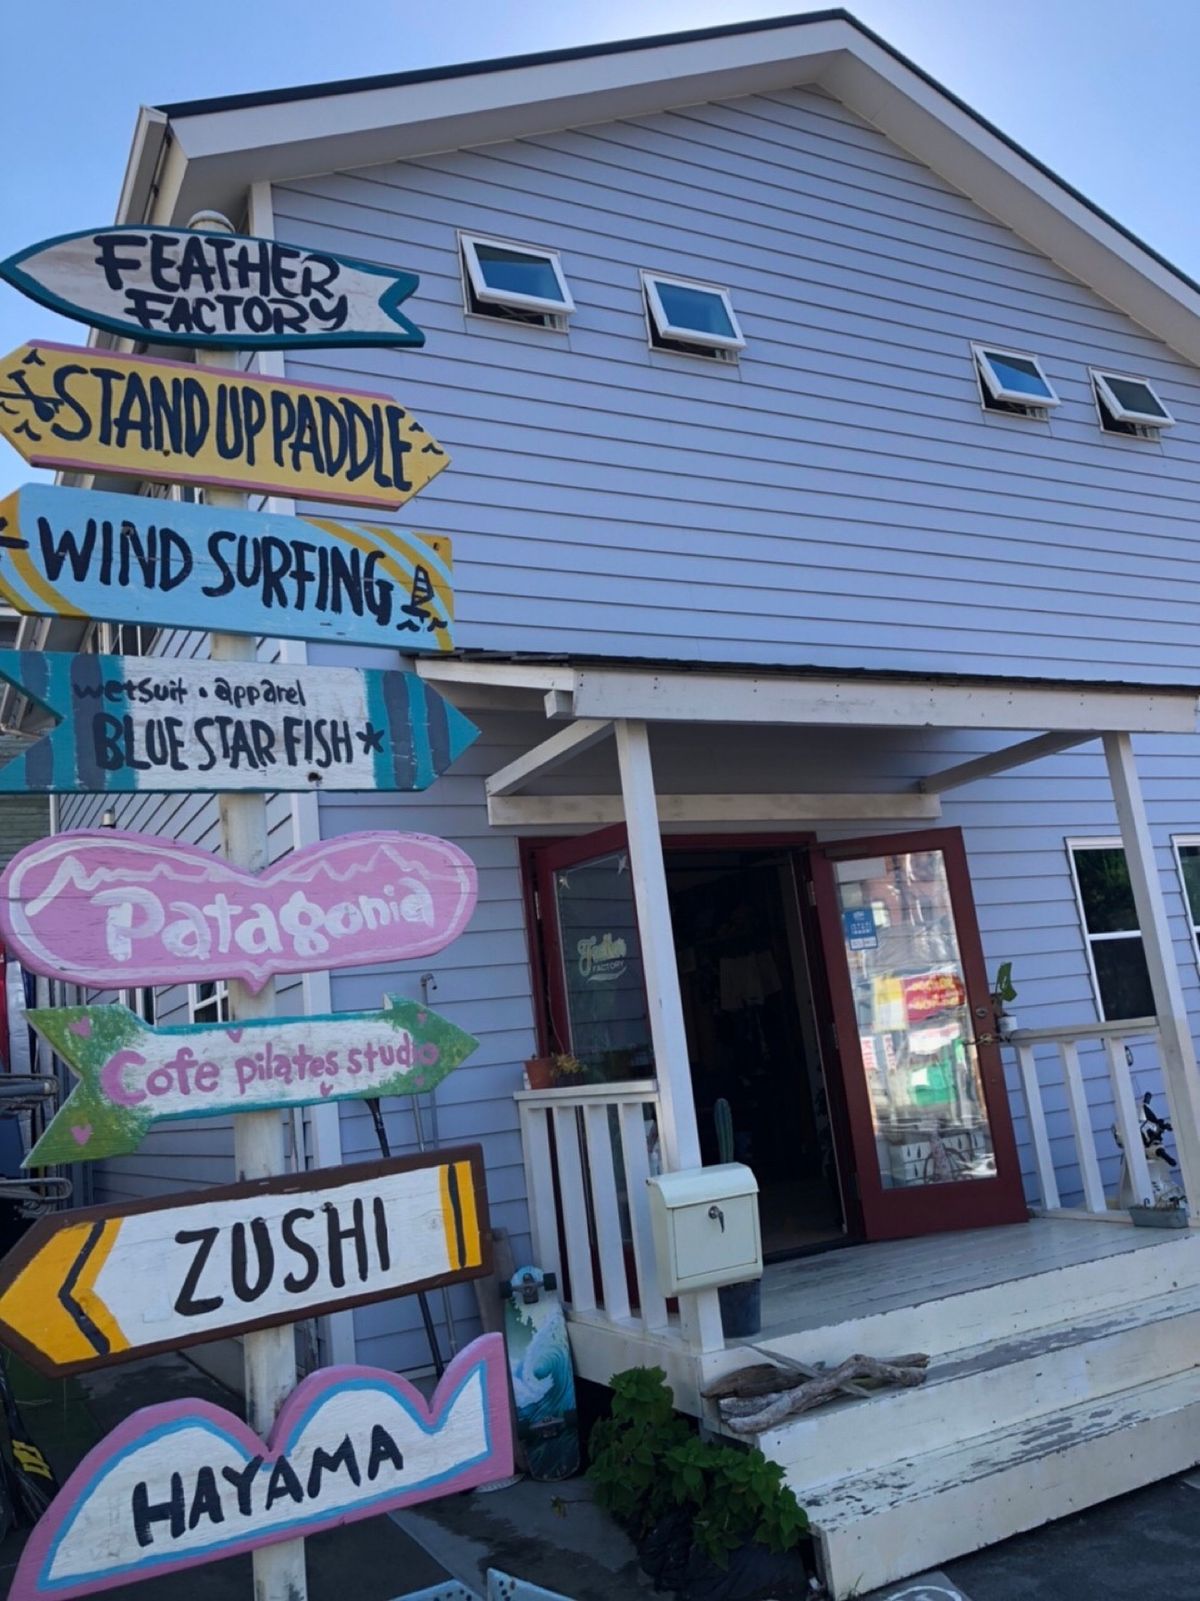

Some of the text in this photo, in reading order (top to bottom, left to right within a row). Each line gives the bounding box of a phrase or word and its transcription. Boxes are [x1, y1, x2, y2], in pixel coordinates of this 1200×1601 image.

[93, 233, 341, 300] FEATHER
[124, 288, 348, 335] FACTORY
[51, 364, 413, 492] STAND UP PADDLE
[37, 516, 394, 626] WIND SURFING
[214, 678, 306, 708] apparel
[93, 714, 354, 771] BLUE STAR FISH
[90, 877, 435, 962] Patagonia
[235, 1042, 339, 1095] pilates
[346, 1032, 440, 1075] studio
[173, 1197, 391, 1317] ZUSHI
[131, 1424, 404, 1547] HAYAMA
